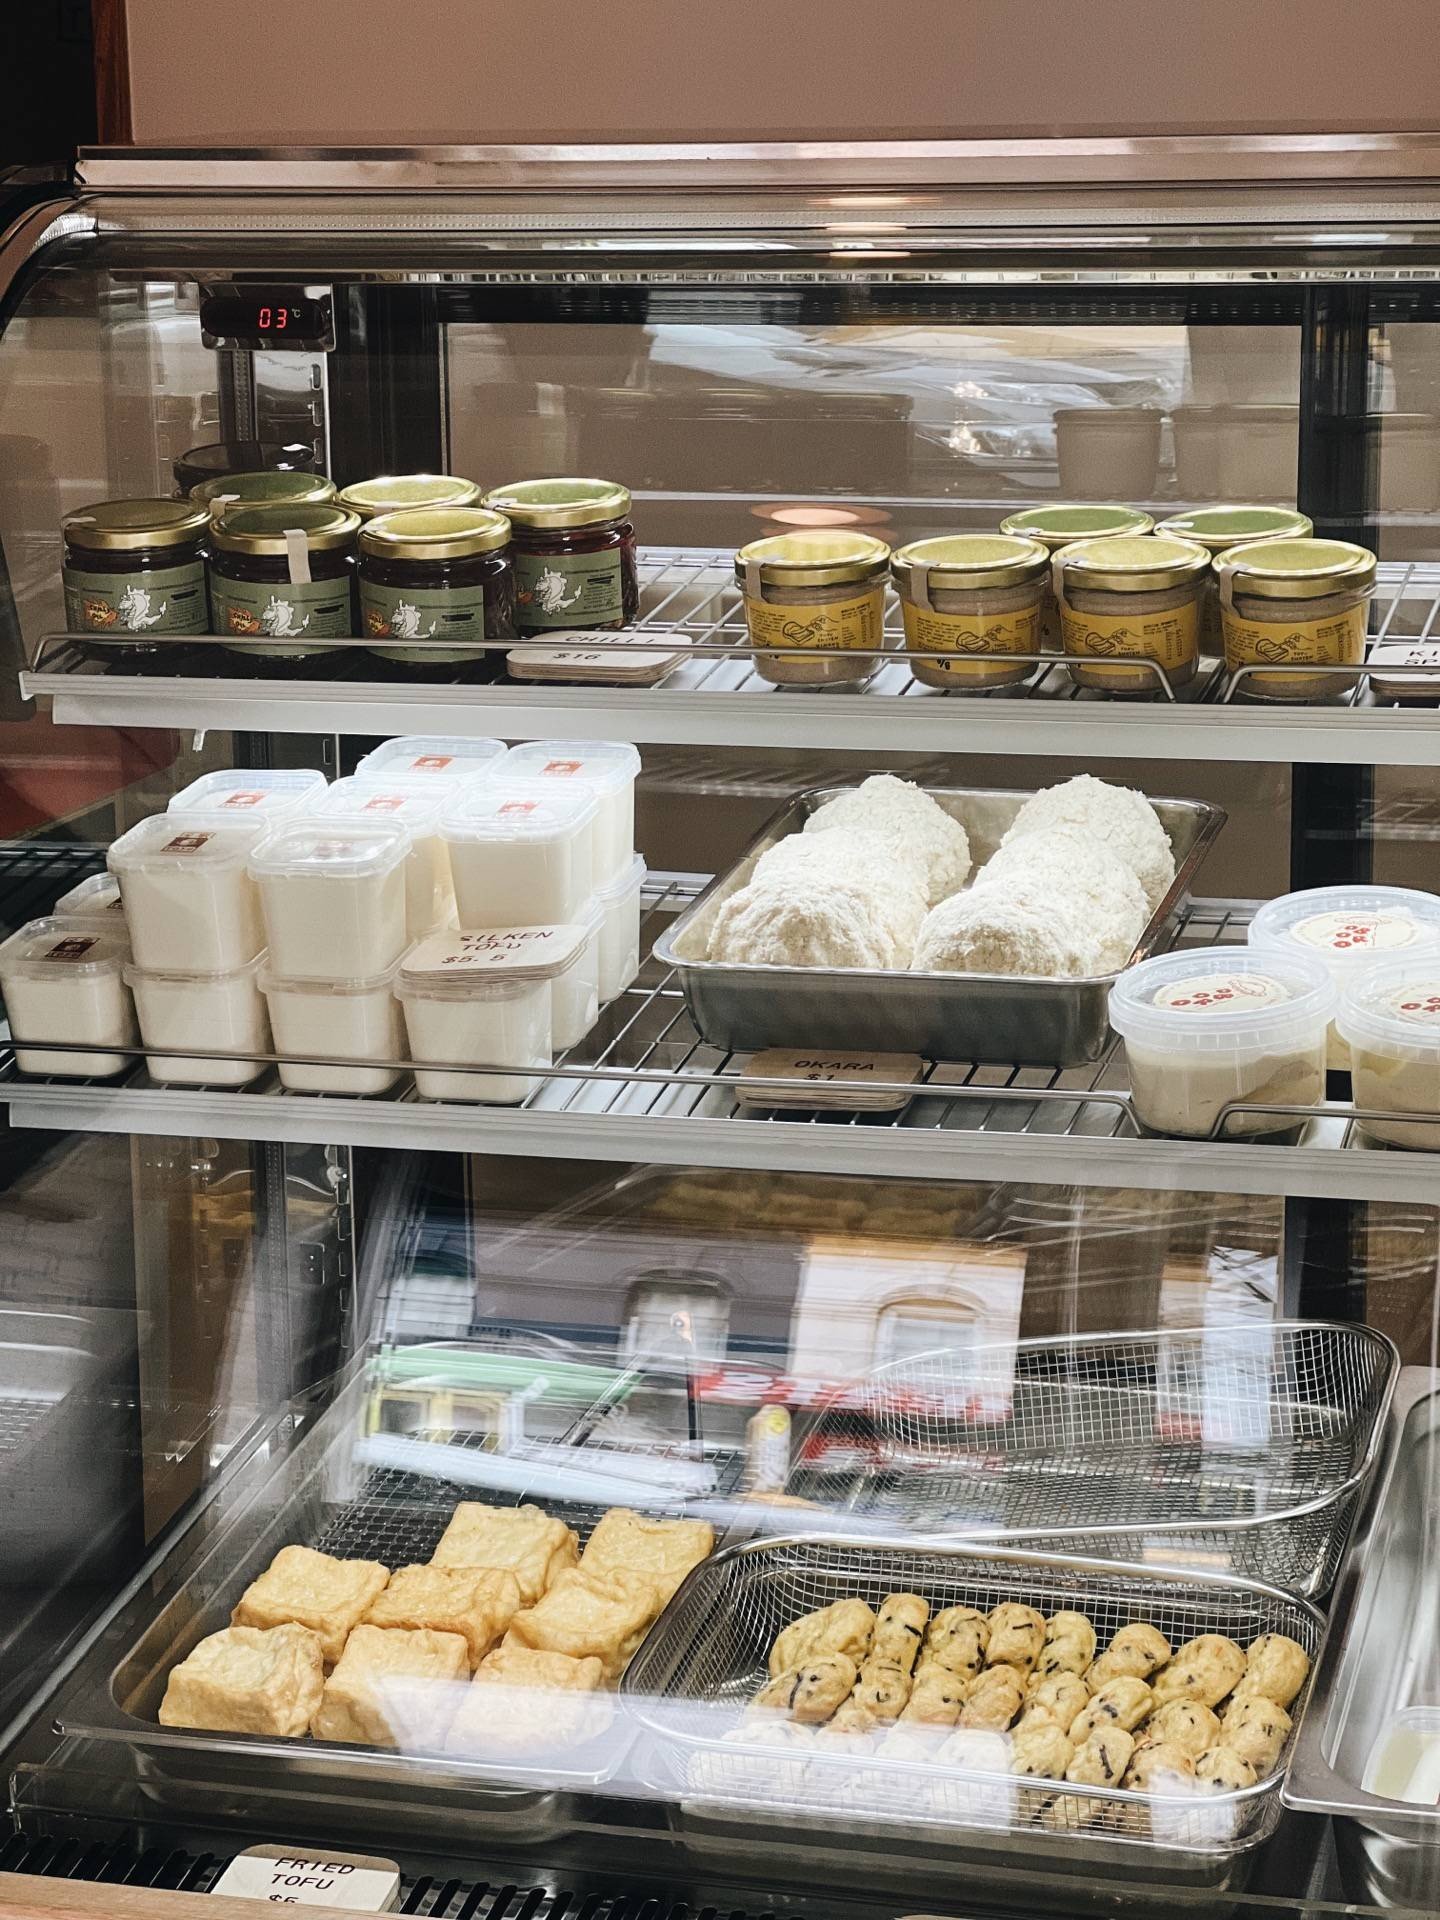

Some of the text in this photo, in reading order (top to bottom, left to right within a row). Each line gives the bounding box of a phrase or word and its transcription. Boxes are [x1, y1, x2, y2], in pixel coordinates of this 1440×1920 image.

[259, 308, 287, 328] 03
[553, 652, 602, 661] $16
[459, 931, 554, 943] SILKEN
[461, 941, 522, 951] TOFU
[794, 1060, 875, 1071] OKARA
[803, 1073, 835, 1081] $1
[274, 1857, 356, 1875] FRIED
[271, 1873, 334, 1890] TOFU
